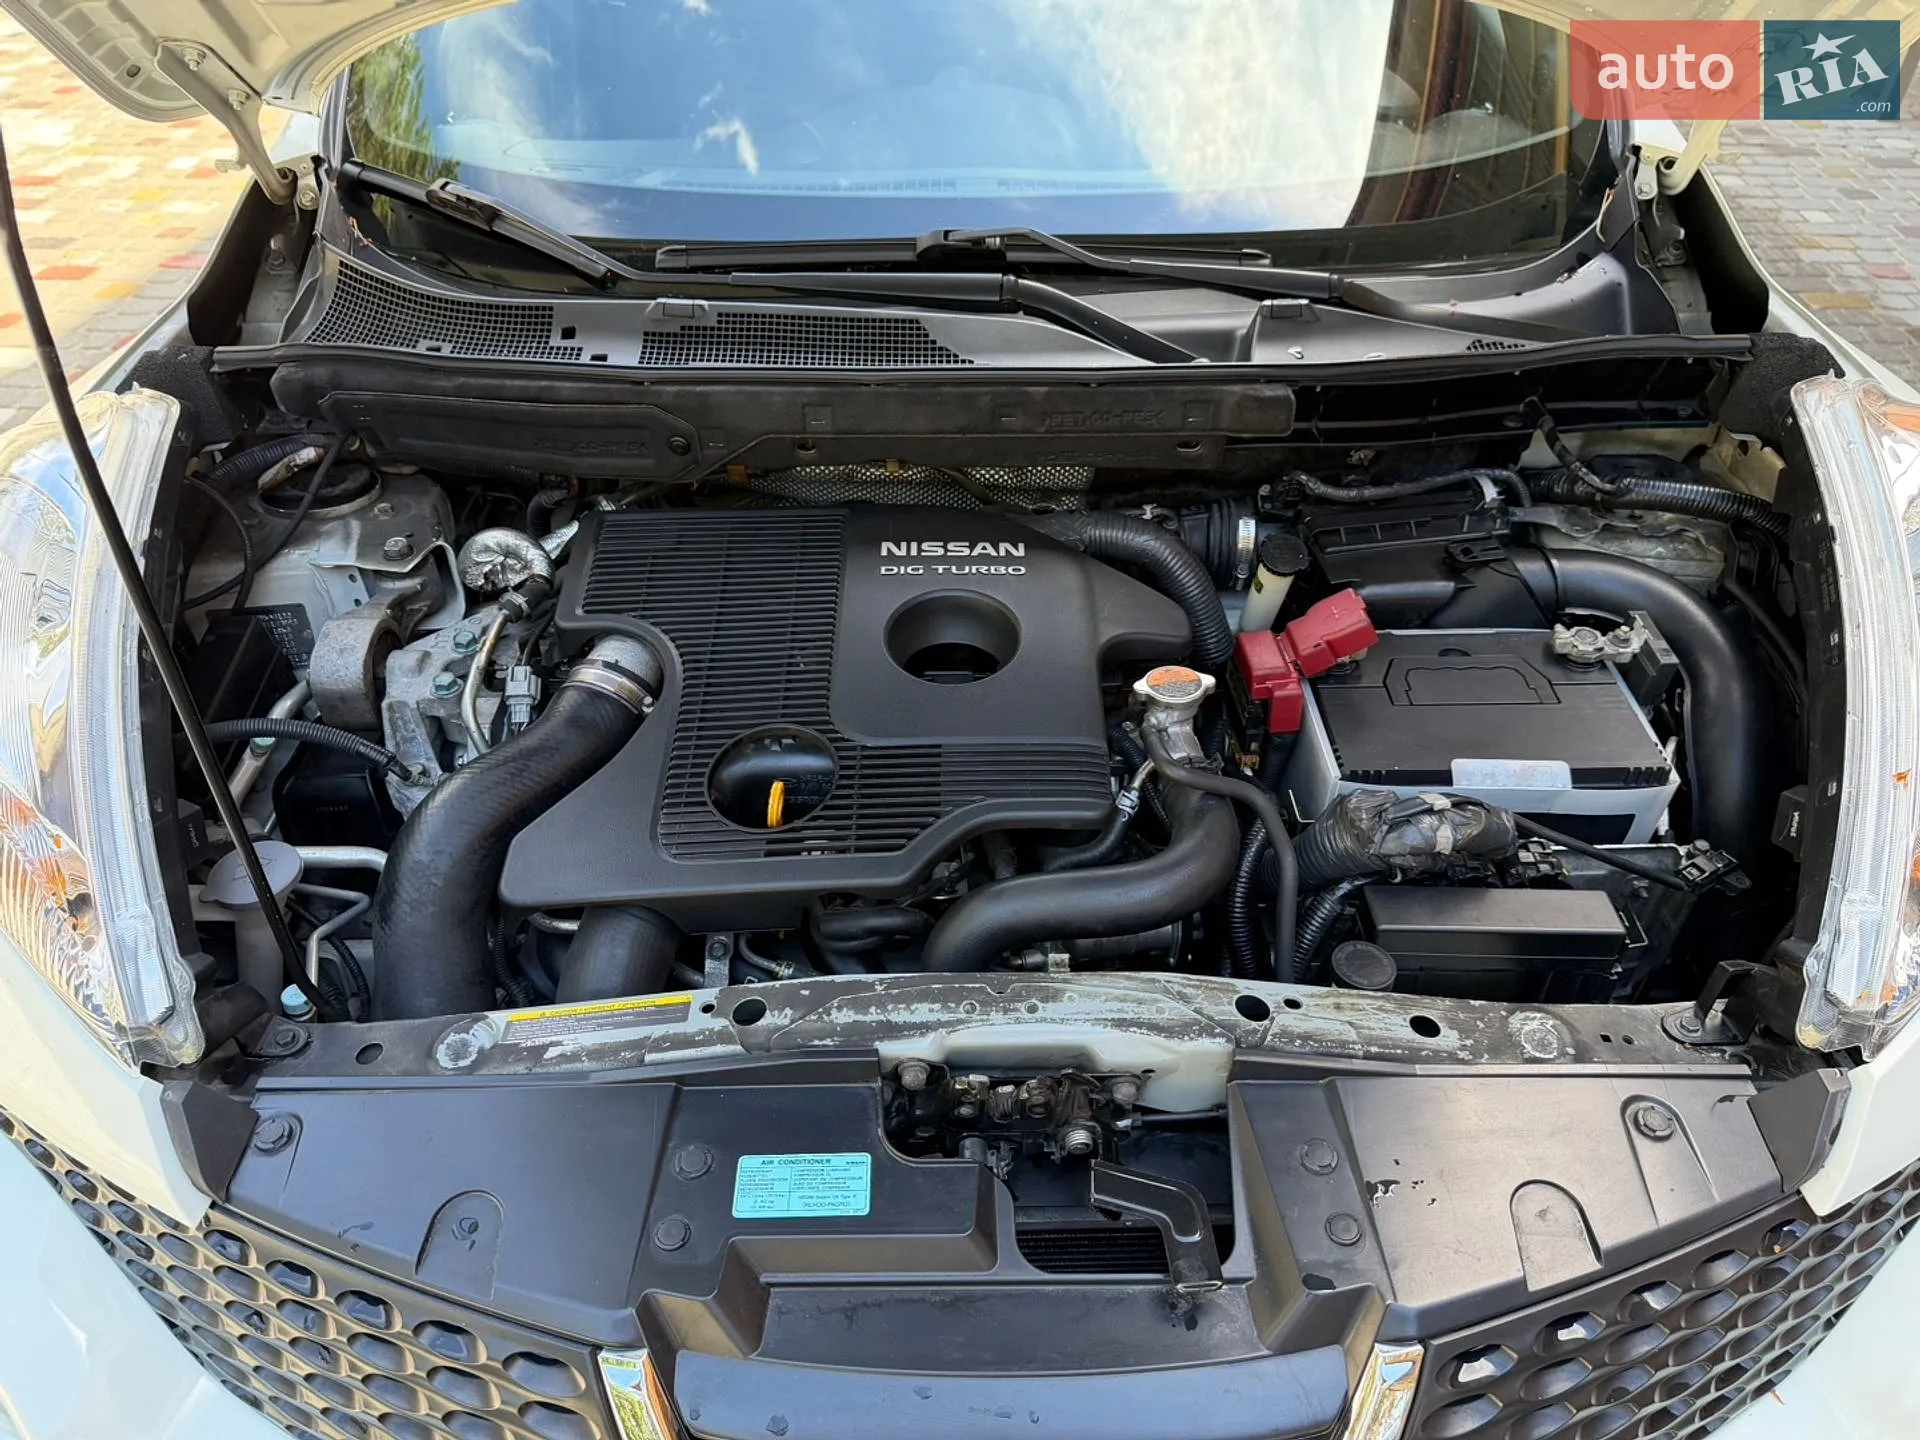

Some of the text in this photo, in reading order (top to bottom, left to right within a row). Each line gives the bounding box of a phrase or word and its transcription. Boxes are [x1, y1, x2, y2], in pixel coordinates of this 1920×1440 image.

[880, 541, 1026, 557] NISSAN
[880, 565, 1026, 575] DIG TURBO
[777, 1158, 832, 1166] CONDITIONER
